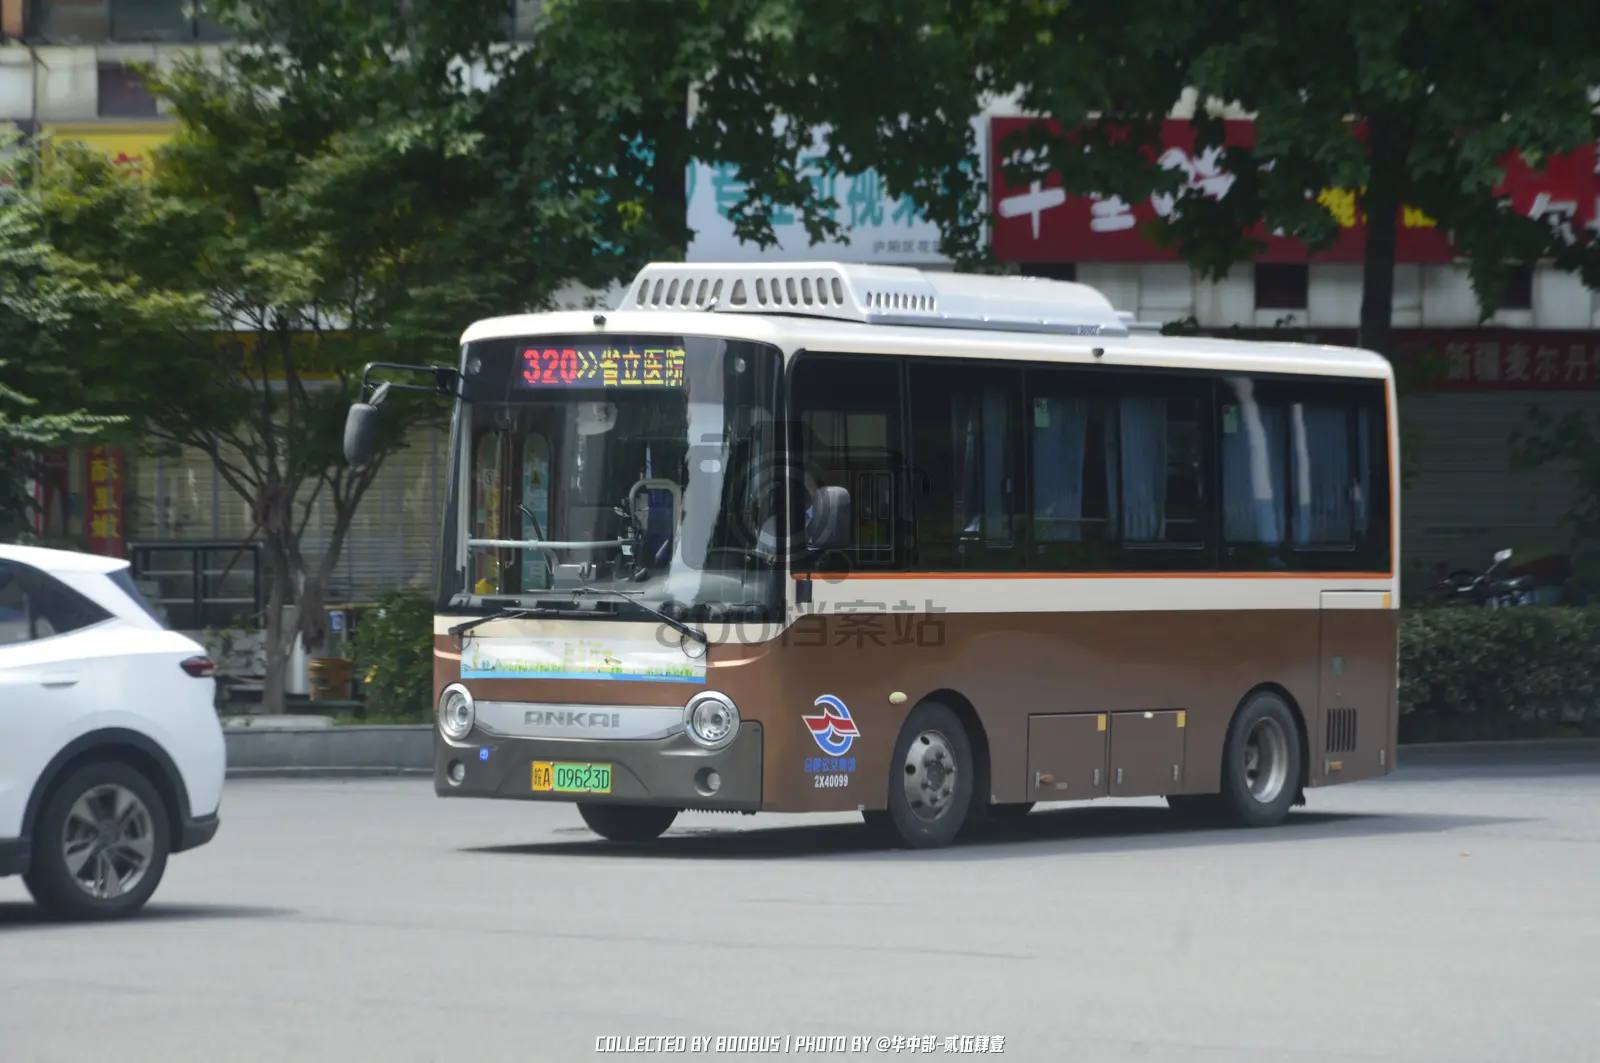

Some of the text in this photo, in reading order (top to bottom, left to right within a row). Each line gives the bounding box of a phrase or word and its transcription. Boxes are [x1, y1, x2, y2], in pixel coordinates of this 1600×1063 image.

[523, 346, 686, 387] 320 省立医院
[524, 711, 620, 728] ANKAI
[814, 775, 849, 788] 2X40099
